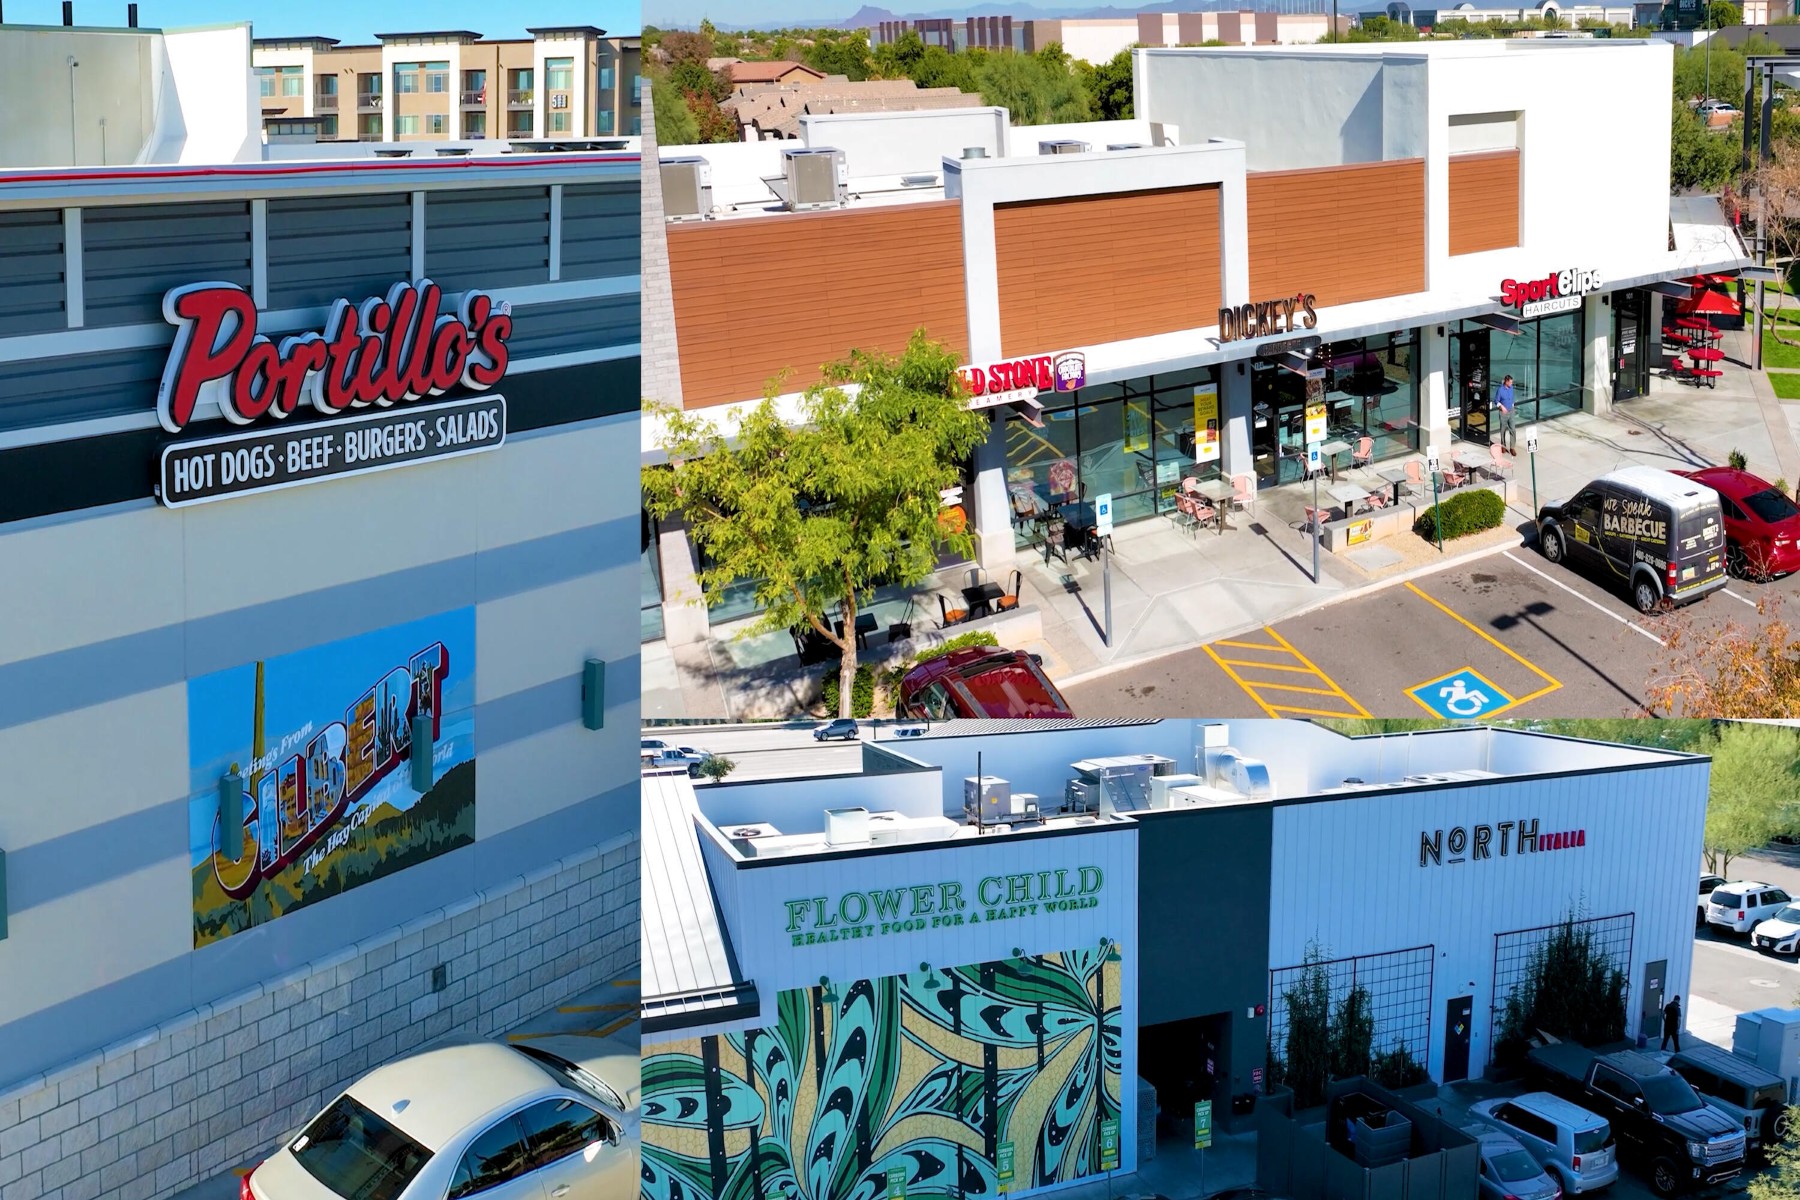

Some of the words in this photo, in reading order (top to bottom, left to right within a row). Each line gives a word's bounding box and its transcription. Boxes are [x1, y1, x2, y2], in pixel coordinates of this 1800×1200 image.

[1218, 293, 1317, 343] DICKEY'S
[1525, 297, 1580, 315] HAIRCUTS
[988, 356, 1053, 394] STONE
[174, 453, 216, 493] HOT
[221, 445, 275, 486] DOGS
[287, 435, 334, 474] BEEF
[344, 420, 426, 464] BURGERS
[435, 408, 499, 448] SALADS
[1604, 514, 1666, 539] BARBECUE
[280, 720, 313, 756] From
[212, 641, 448, 899] GILBERT
[303, 846, 326, 875] The
[322, 823, 350, 856] Hay
[432, 742, 454, 768] orld
[1420, 818, 1539, 867] NORTH
[1539, 830, 1586, 852] ITALIA
[784, 881, 966, 933] FLOWER
[978, 866, 1104, 908] CHILD
[792, 925, 876, 947] HEALTHY
[881, 918, 927, 935] FOOD
[932, 914, 964, 929] FOR
[969, 911, 981, 924] A
[985, 904, 1039, 922] HAPPY
[1044, 897, 1099, 914] WORLD
[1106, 1138, 1112, 1148] 6
[1200, 1119, 1206, 1128] 7
[1002, 1160, 1009, 1171] 5
